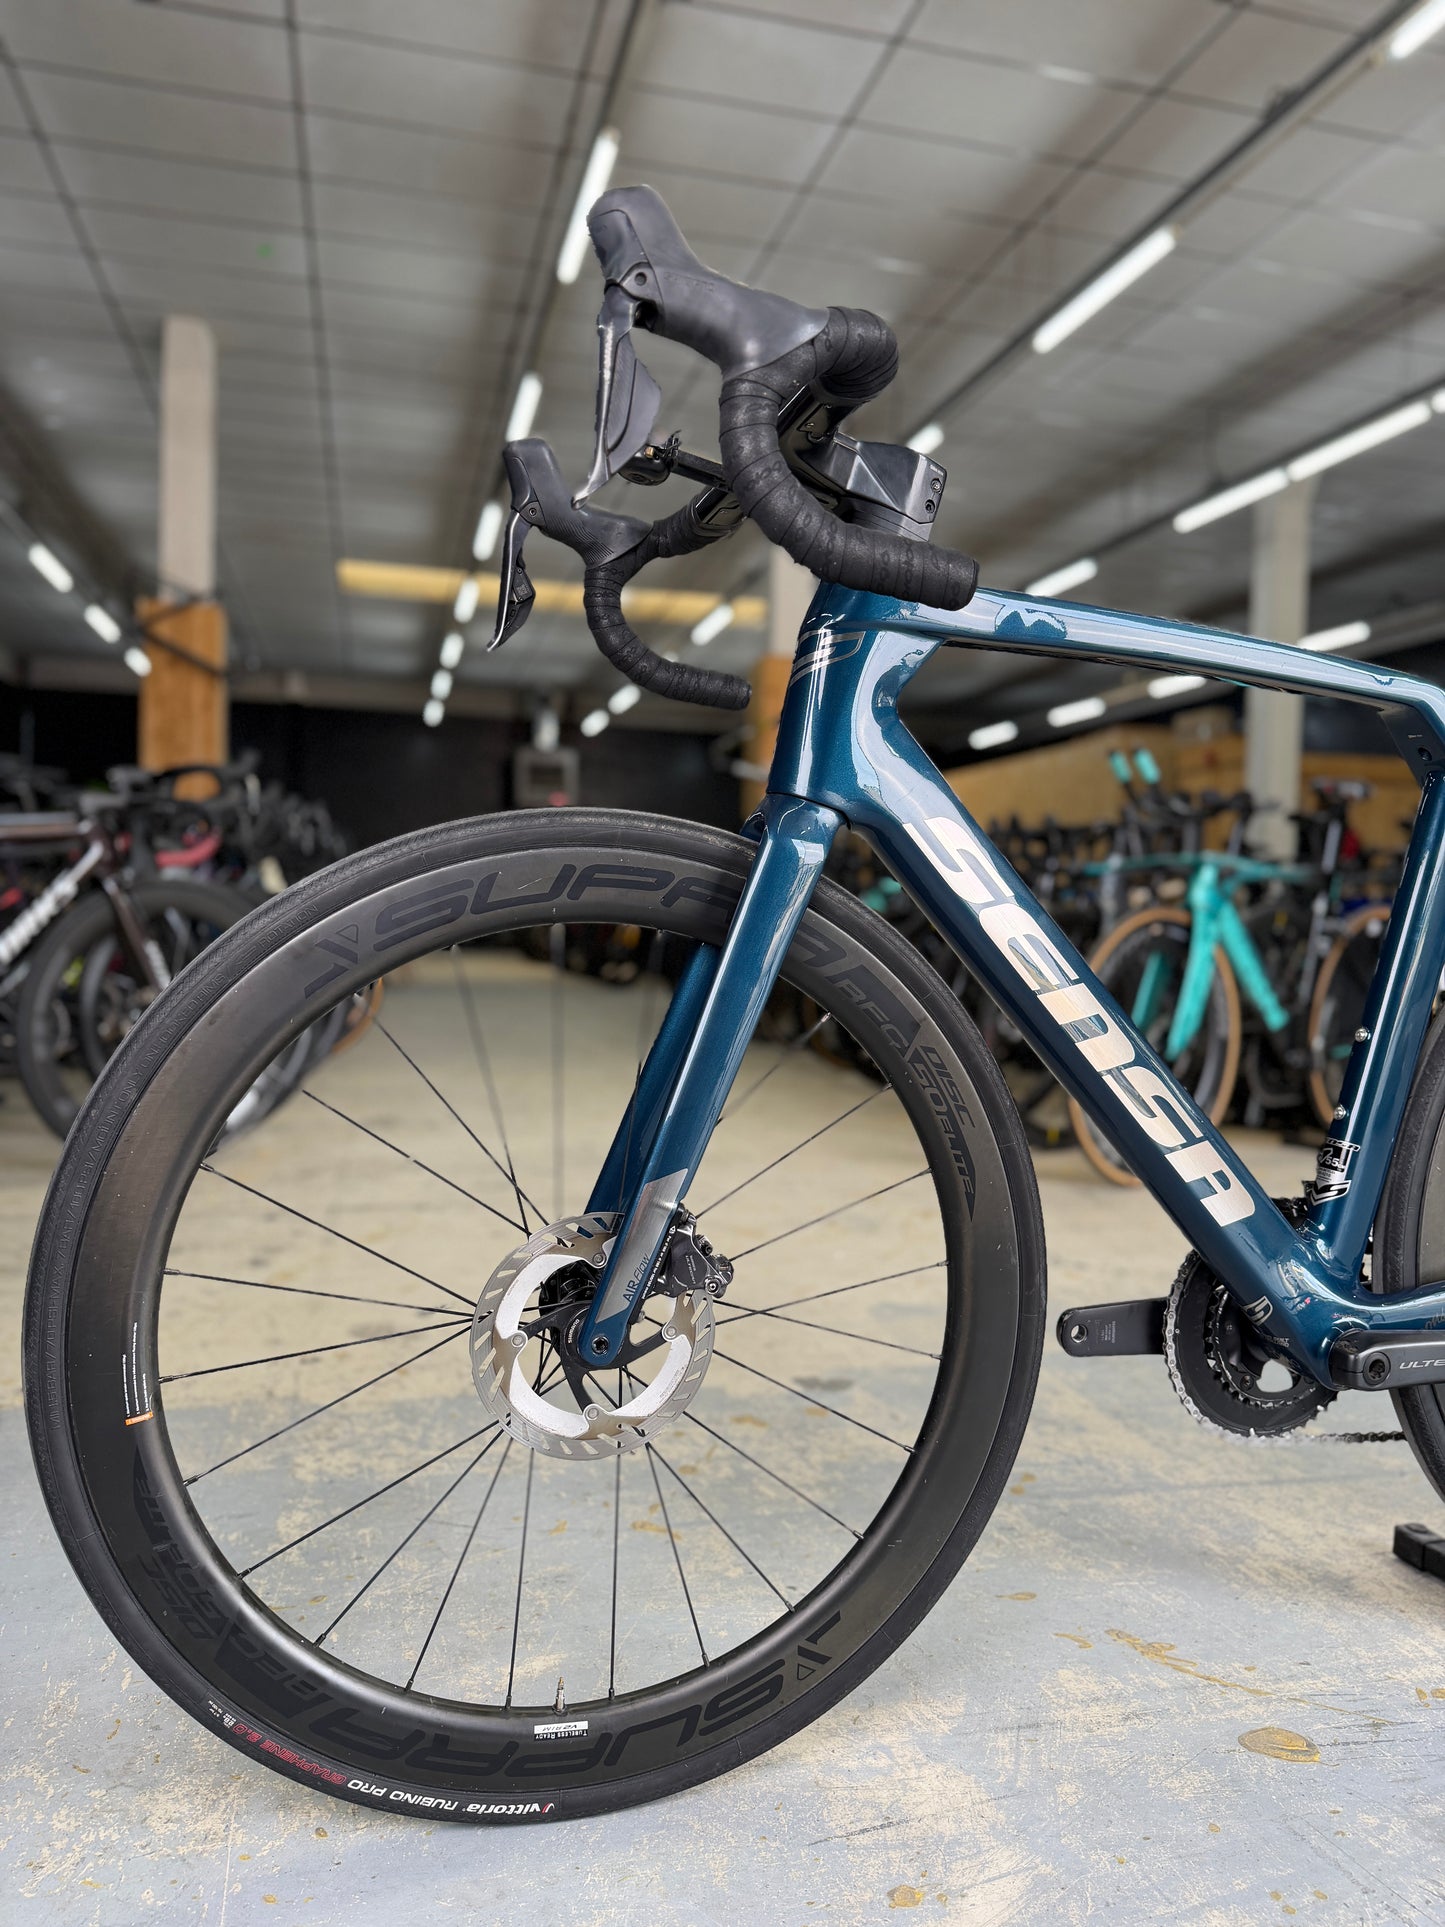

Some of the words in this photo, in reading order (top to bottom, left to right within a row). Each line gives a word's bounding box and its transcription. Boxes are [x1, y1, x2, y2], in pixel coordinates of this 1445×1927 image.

[260, 1739, 348, 1785] GRAPHENE
[347, 1778, 388, 1797] PRO
[389, 1789, 460, 1813] RUBINO
[466, 1802, 542, 1816] vittoria
